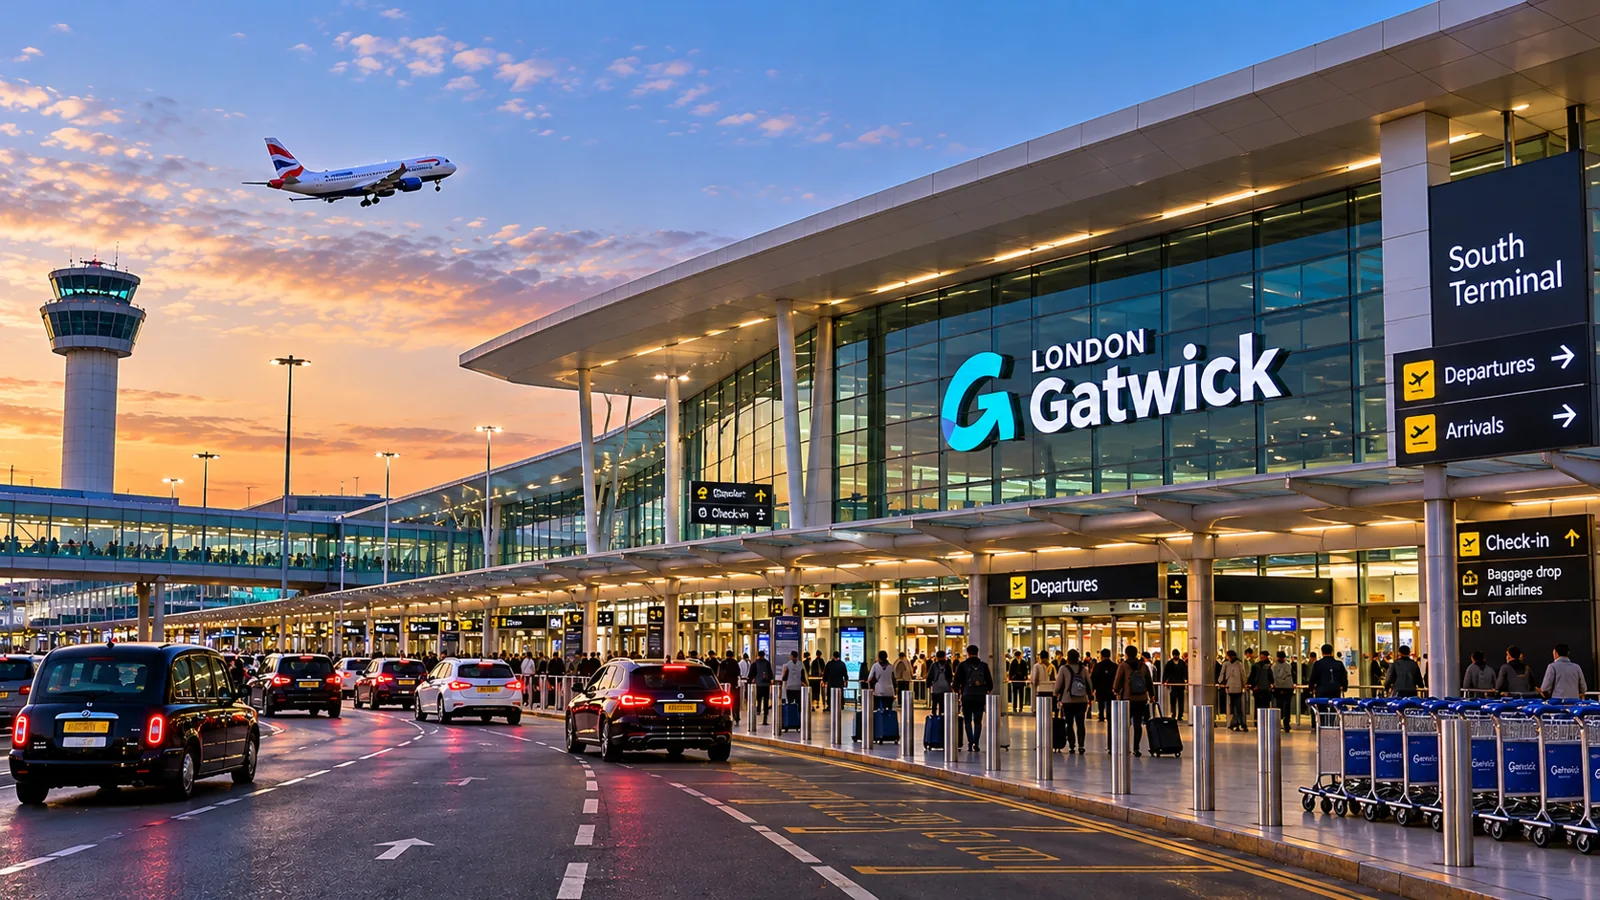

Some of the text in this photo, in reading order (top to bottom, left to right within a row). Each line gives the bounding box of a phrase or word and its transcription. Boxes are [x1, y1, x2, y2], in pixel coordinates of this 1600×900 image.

[1449, 232, 1526, 272] South
[1449, 260, 1563, 307] Terminal
[1031, 328, 1146, 373] LONDON
[1029, 331, 1284, 434] Gatwick
[1444, 357, 1535, 386] Departures
[1445, 416, 1505, 440] Arrivals
[1486, 532, 1550, 551] Check-in
[1487, 566, 1562, 582] Baggage drop
[1031, 577, 1098, 598] Departures
[1487, 584, 1543, 597] All airlines
[1487, 611, 1527, 625] Toilets
